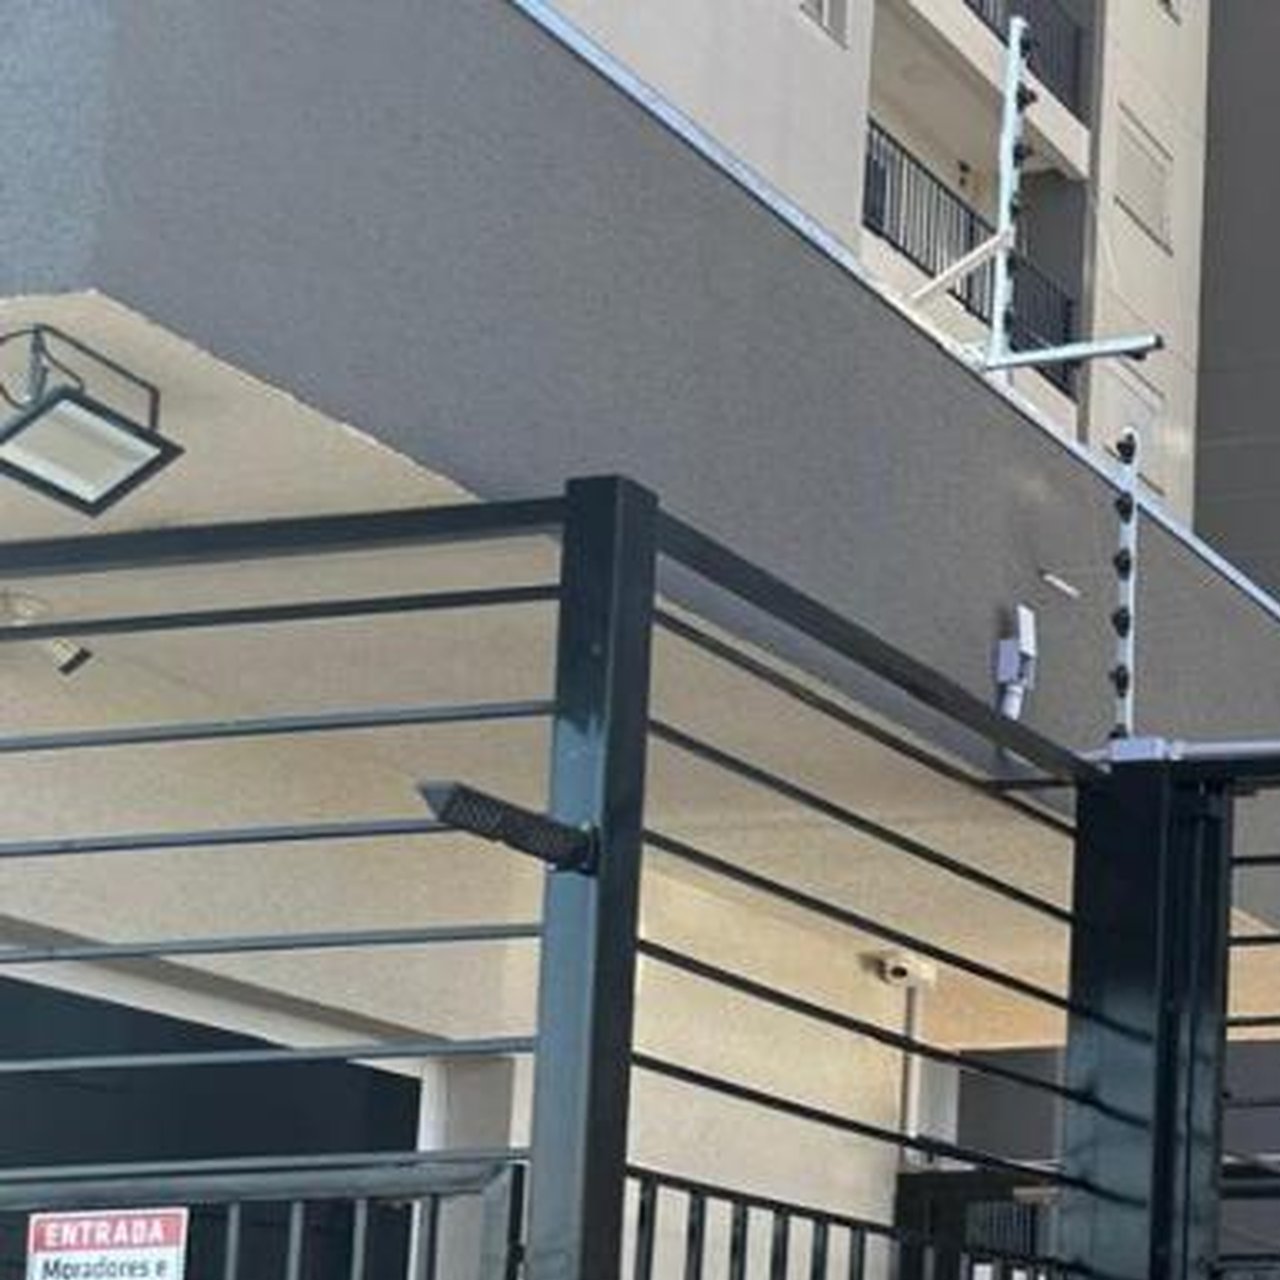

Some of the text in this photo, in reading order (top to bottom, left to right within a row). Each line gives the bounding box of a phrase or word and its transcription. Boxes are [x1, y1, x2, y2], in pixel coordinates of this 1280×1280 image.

[44, 1218, 165, 1248] ENTRADA
[41, 1258, 168, 1280] Moradores e
